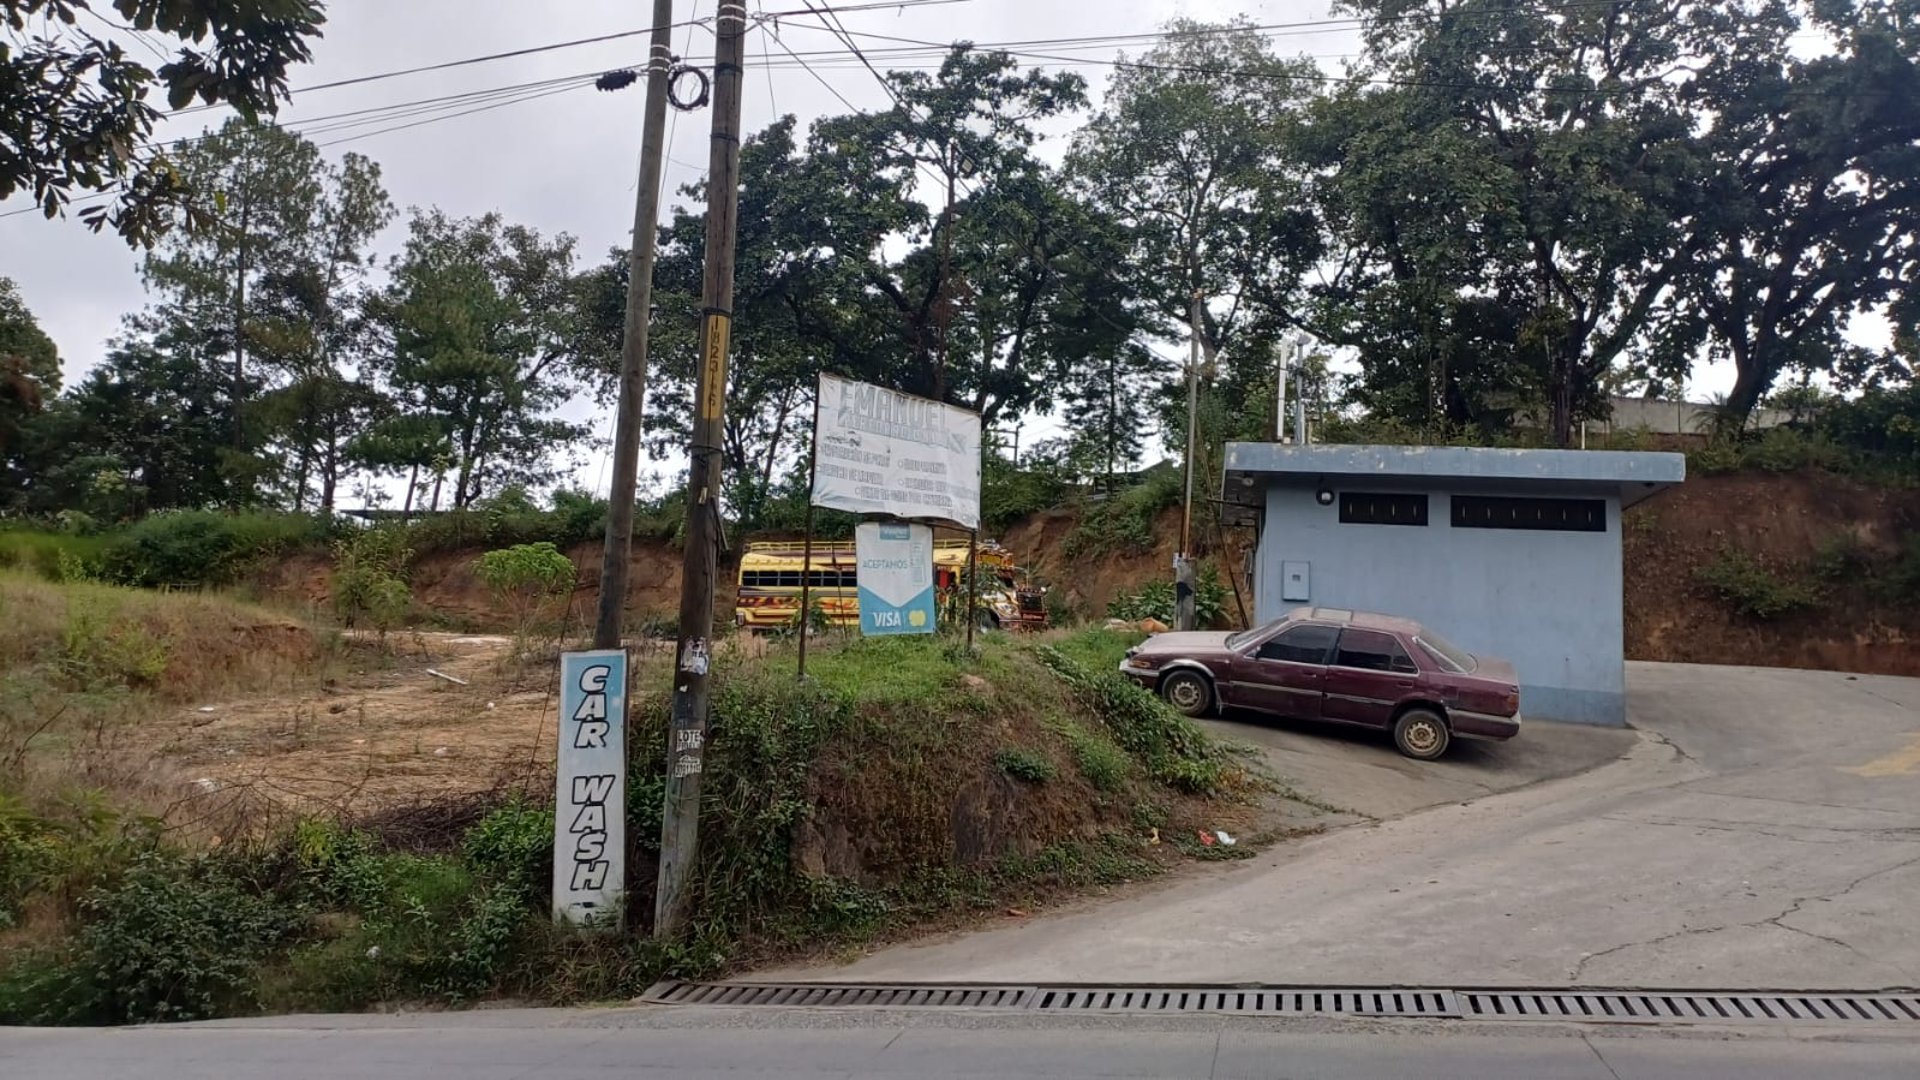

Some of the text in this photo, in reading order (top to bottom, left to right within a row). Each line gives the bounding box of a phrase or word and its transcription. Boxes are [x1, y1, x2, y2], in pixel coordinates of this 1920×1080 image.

[840, 380, 947, 428] EMANUEL
[863, 559, 908, 569] ACEPTAMOS
[873, 611, 901, 627] VISA
[569, 664, 616, 891] CAR WASH
